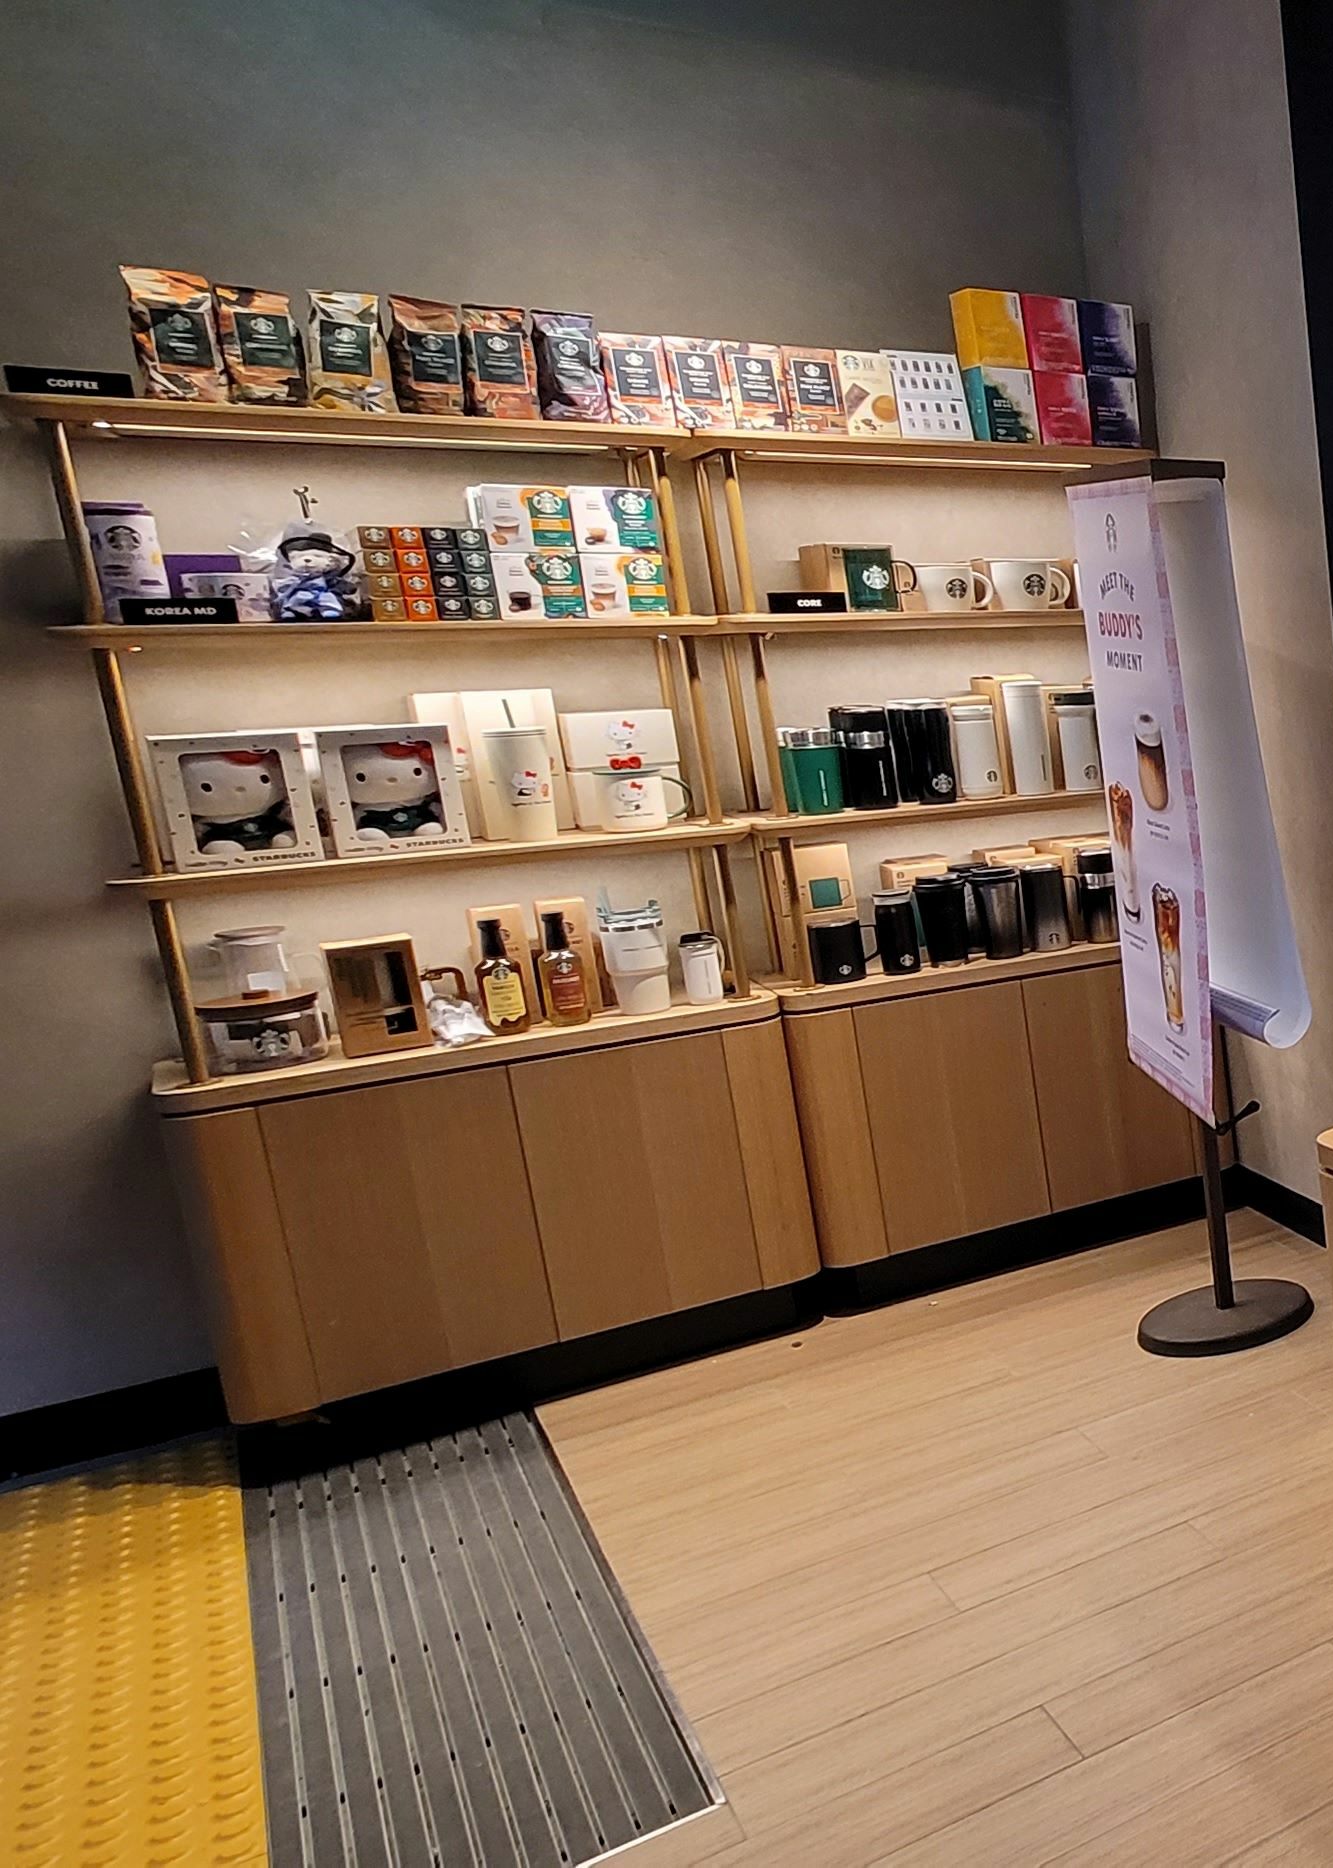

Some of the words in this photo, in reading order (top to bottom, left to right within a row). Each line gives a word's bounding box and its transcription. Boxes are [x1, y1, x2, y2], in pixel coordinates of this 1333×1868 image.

[46, 378, 99, 390] COFFEE
[1099, 571, 1118, 600] MEET
[1118, 572, 1135, 602] THE
[797, 599, 822, 608] CORE
[144, 607, 192, 616] KOREA
[193, 606, 217, 615] MD
[1098, 611, 1143, 641] BUDDY'S
[1106, 650, 1143, 672] MOMENT
[405, 838, 464, 848] STARBUCKS
[252, 851, 316, 861] STARBUCKS
